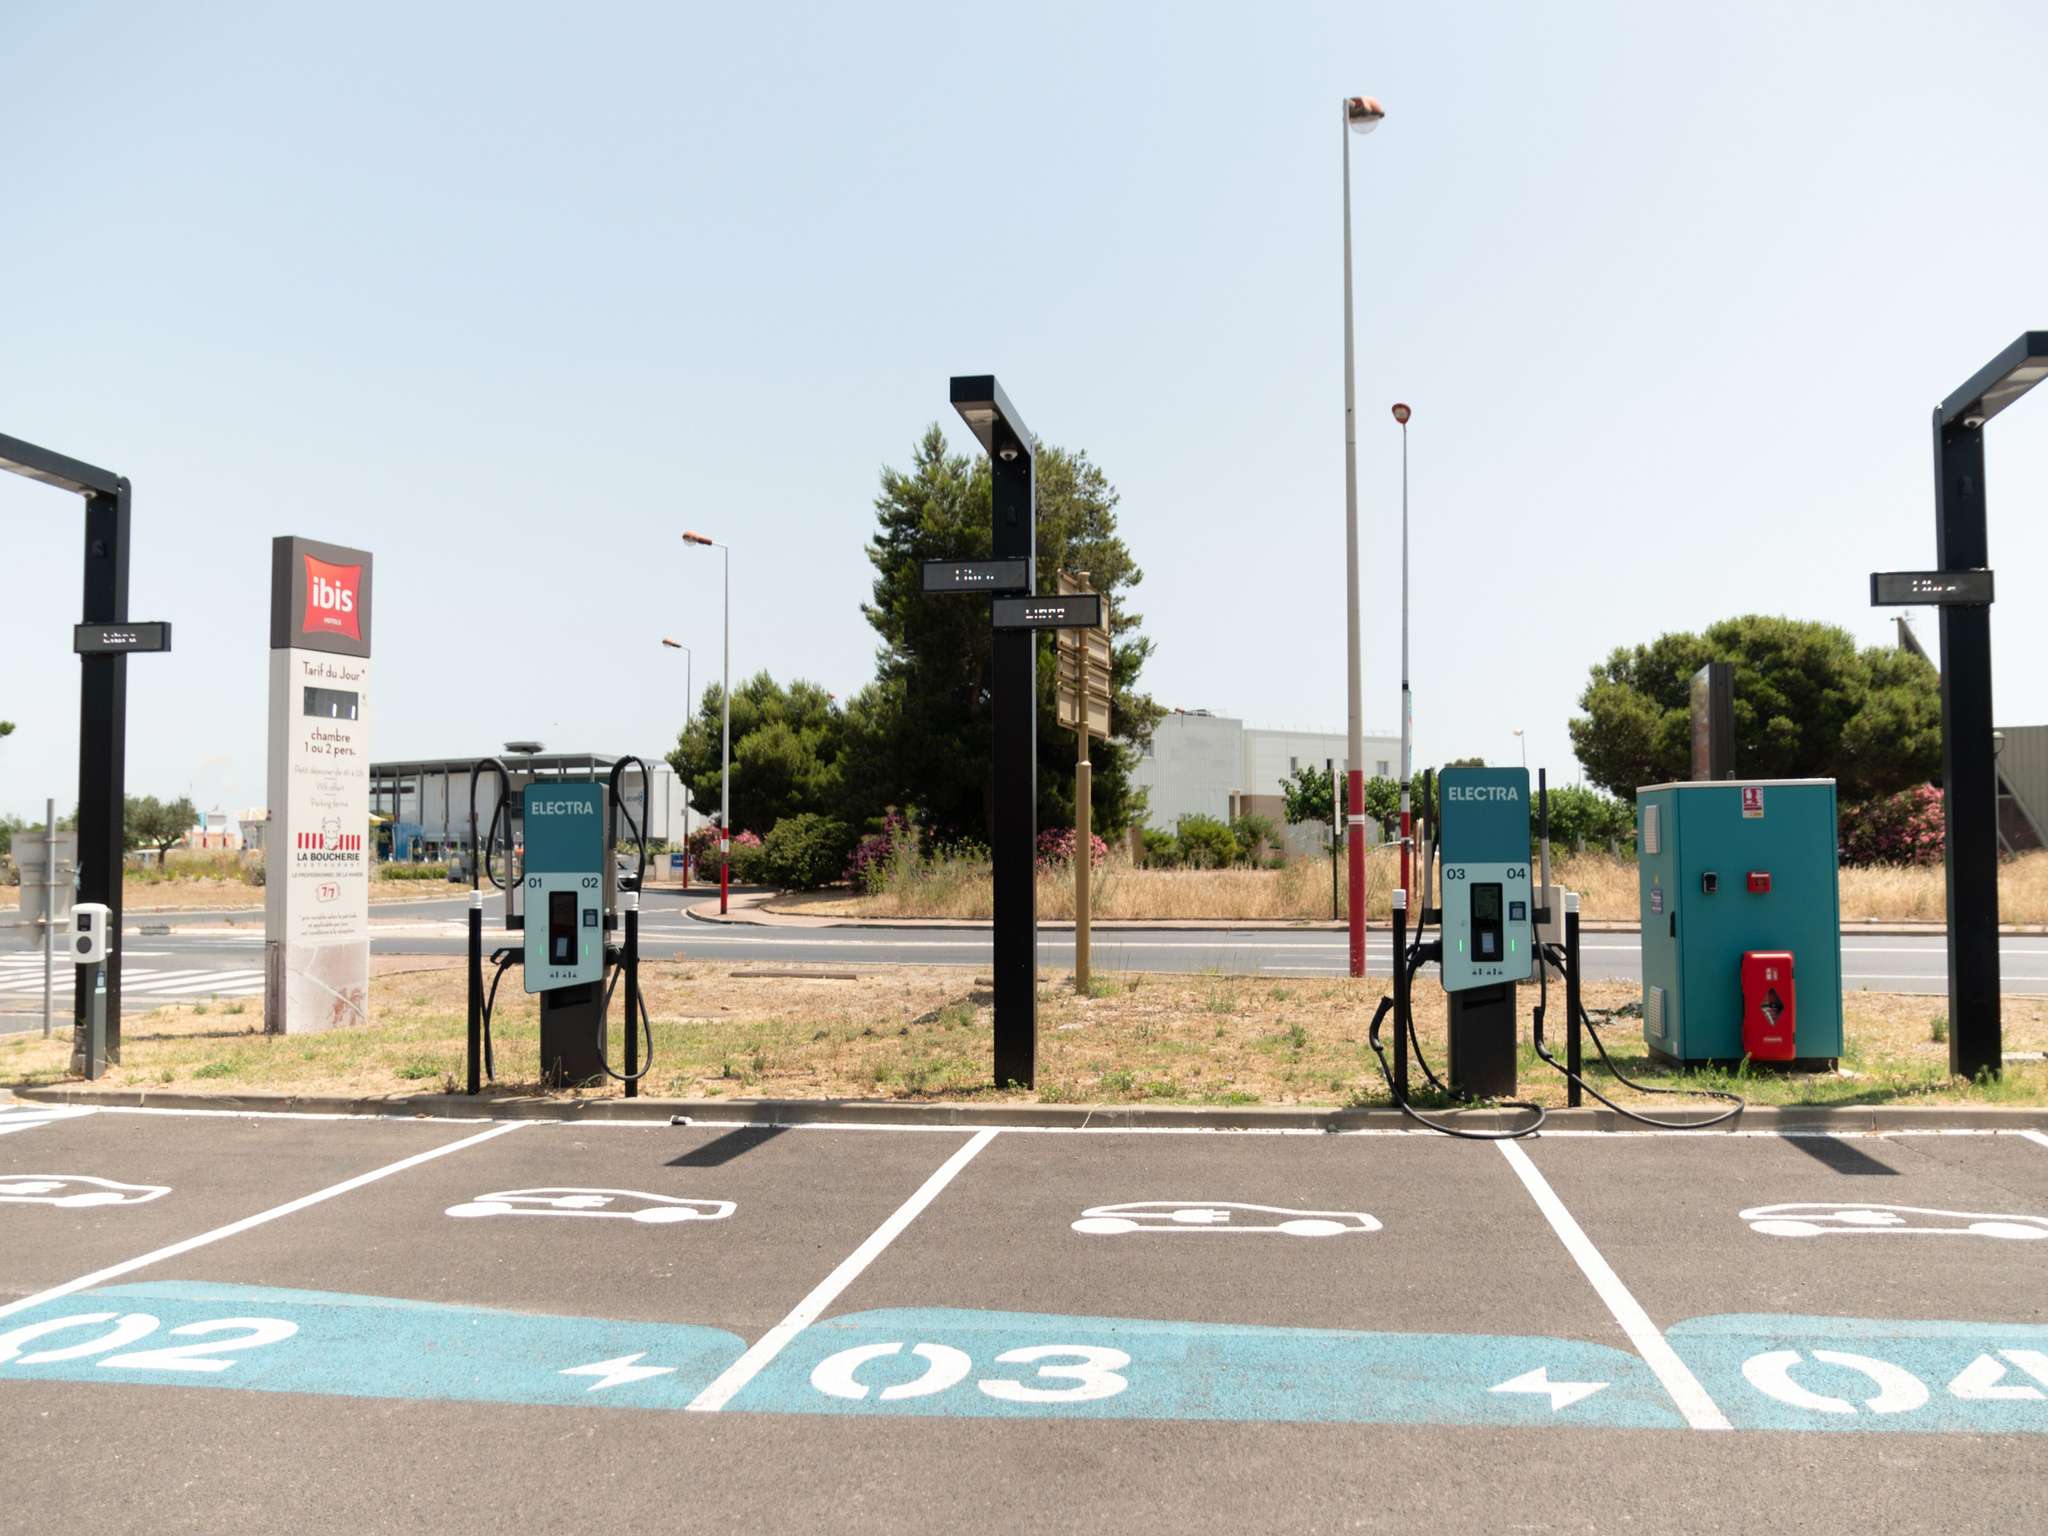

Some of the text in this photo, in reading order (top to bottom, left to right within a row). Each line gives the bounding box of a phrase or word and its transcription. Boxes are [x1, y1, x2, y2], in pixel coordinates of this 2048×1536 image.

[313, 576, 353, 612] ibis
[303, 661, 360, 681] Tarif du Jour
[311, 726, 351, 742] chambre
[304, 742, 357, 758] 1 ou 2 pers.
[1448, 787, 1518, 800] ELECTRA
[531, 801, 594, 815] ELECTRA
[297, 852, 360, 861] LA BOUCHERIE
[1447, 868, 1466, 880] 03
[1507, 868, 1526, 879] 04
[528, 878, 542, 889] 01
[581, 877, 599, 889] 02
[0, 1312, 299, 1373] 02
[810, 1341, 1132, 1403] 03
